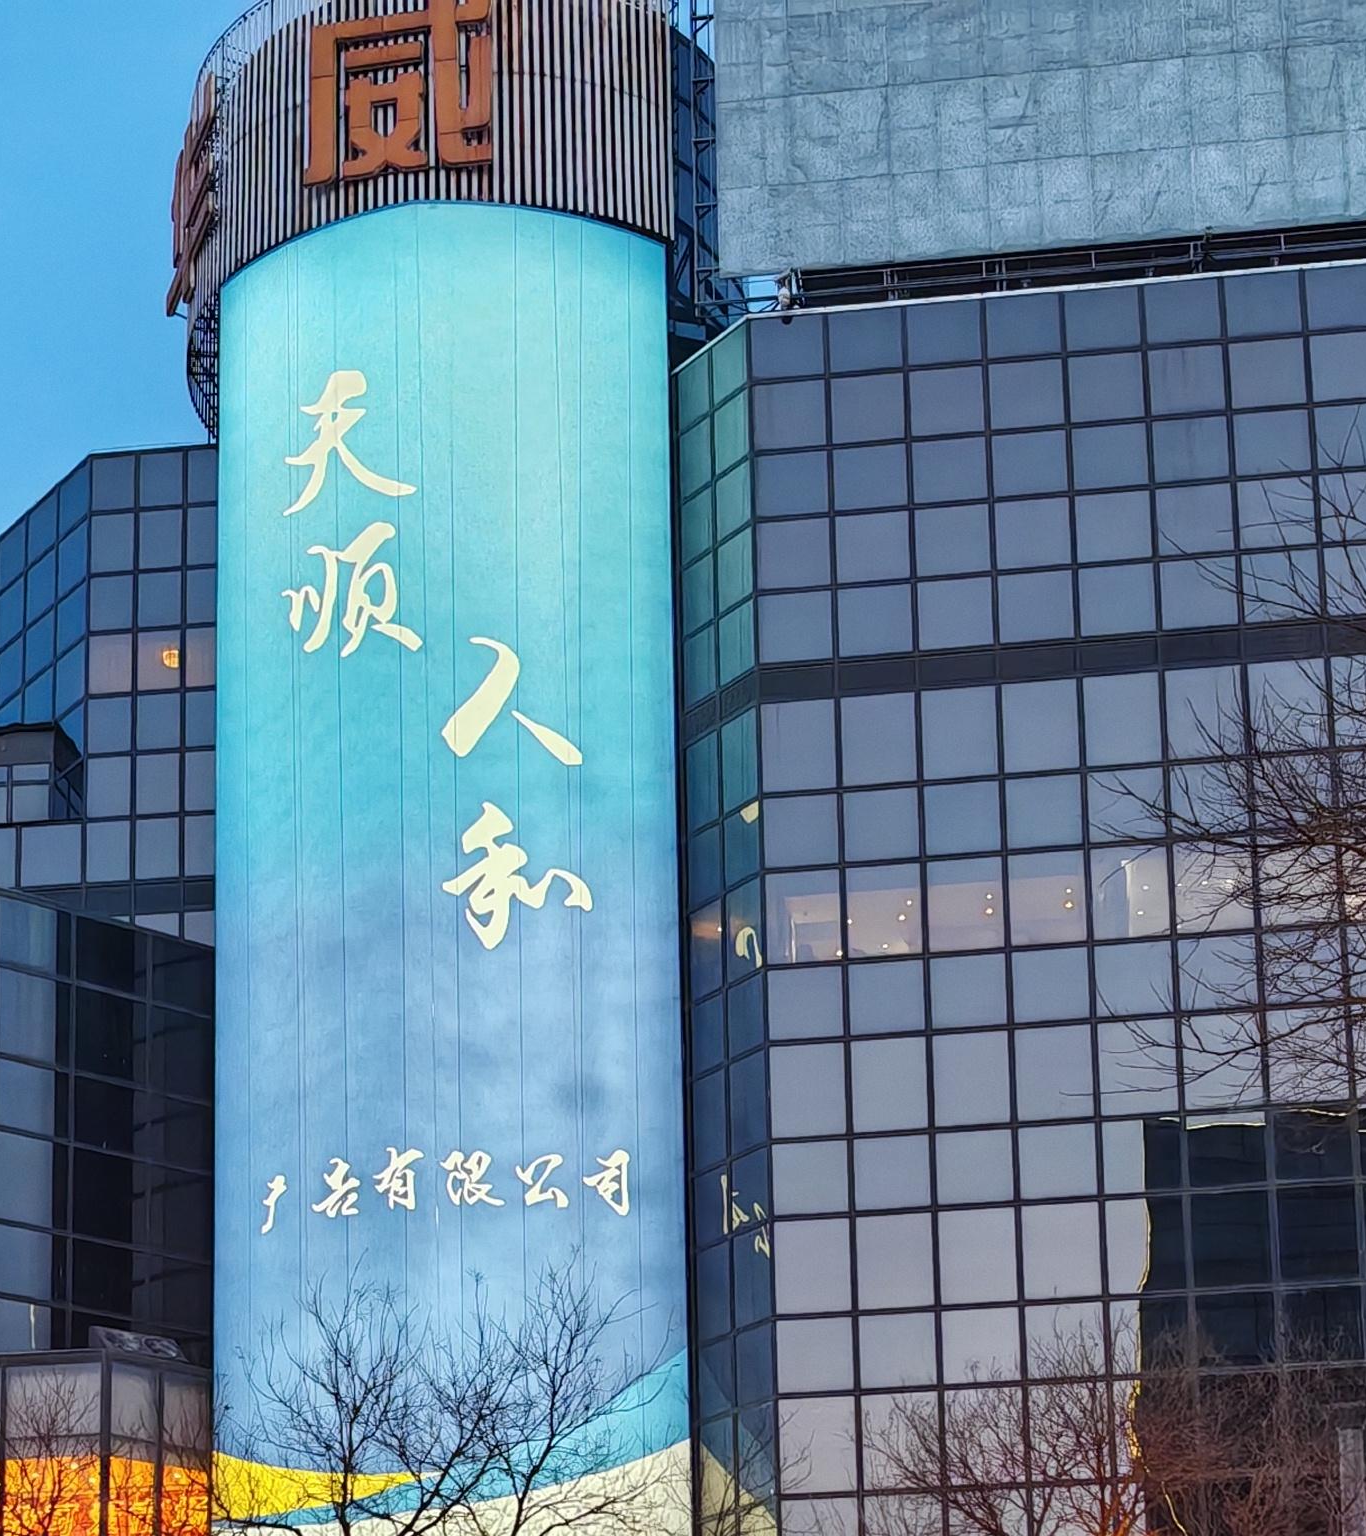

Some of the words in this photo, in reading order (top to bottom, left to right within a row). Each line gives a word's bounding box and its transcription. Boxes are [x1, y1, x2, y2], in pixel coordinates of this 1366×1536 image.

[261, 1147, 632, 1235] 广告有限公司
